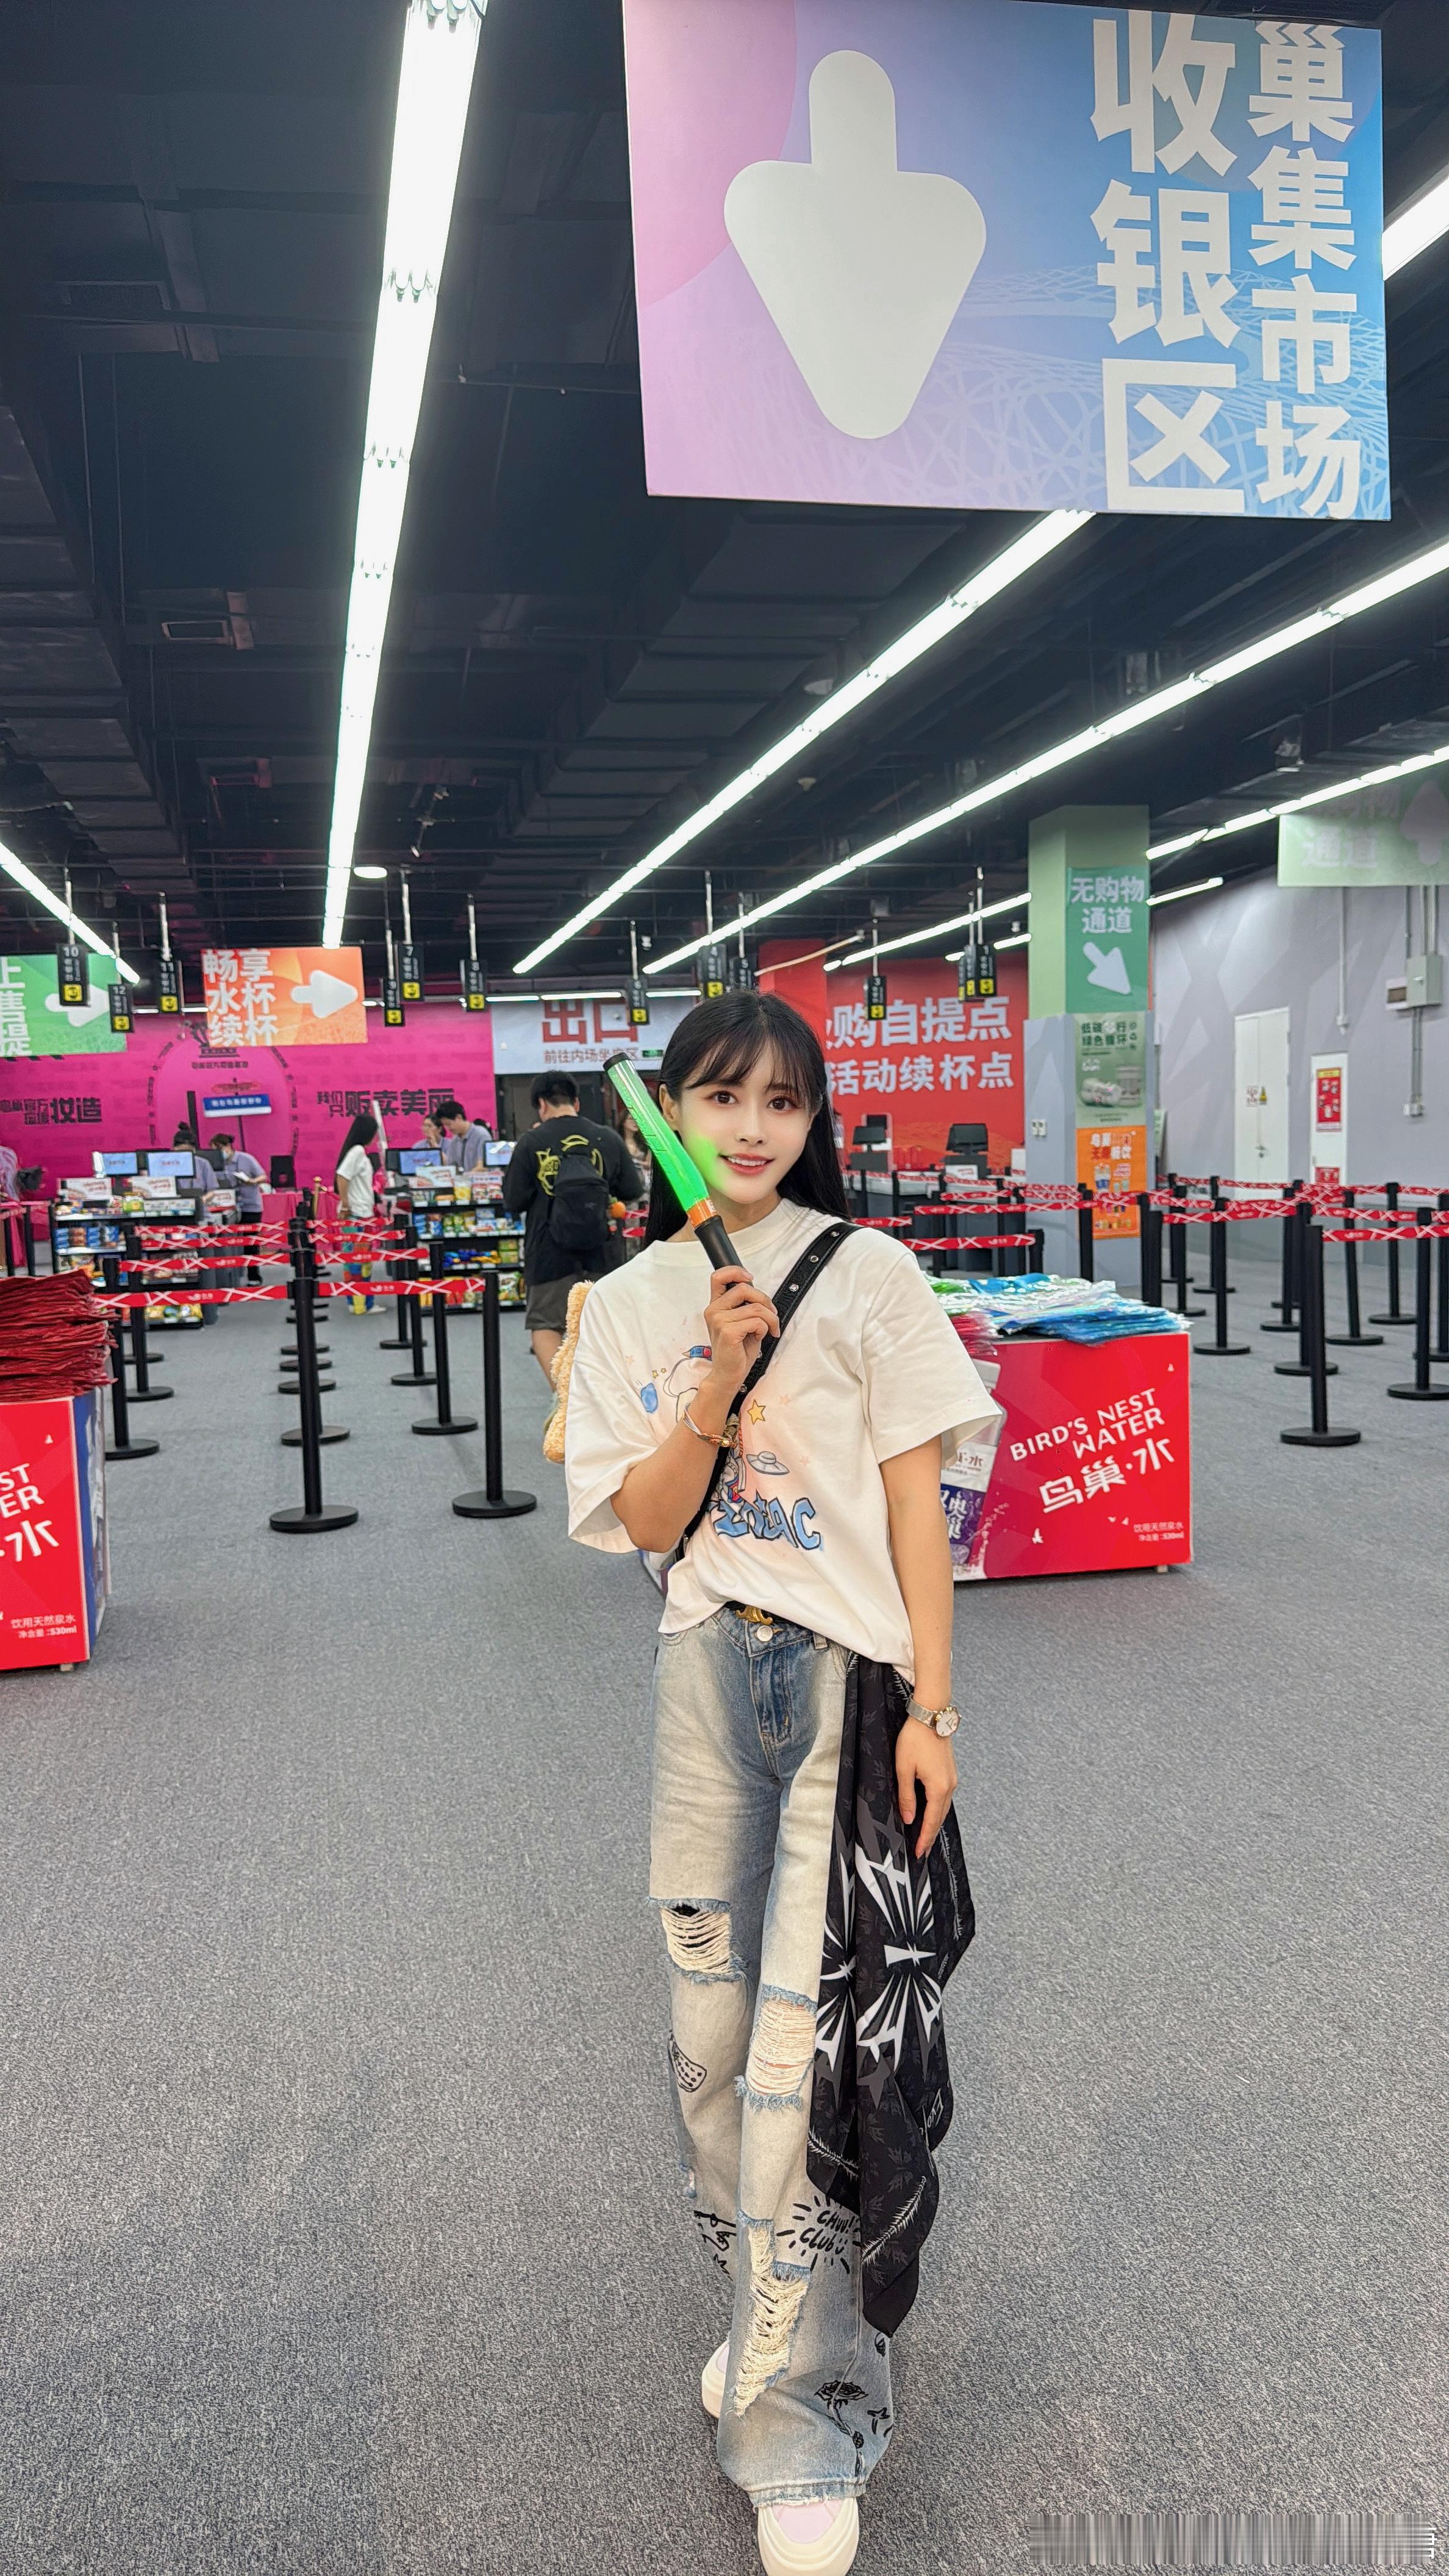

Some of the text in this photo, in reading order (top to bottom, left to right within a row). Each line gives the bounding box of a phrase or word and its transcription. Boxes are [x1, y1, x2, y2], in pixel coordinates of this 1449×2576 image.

[1090, 10, 1245, 513] 收银区
[1248, 20, 1361, 519] 巢集市场
[1071, 875, 1145, 904] 无购物
[1081, 906, 1132, 934] 通道
[63, 946, 79, 957] 10
[160, 962, 174, 972] 11
[202, 948, 273, 983] 畅享
[112, 986, 127, 995] 12
[206, 981, 276, 1015] 水杯
[208, 1014, 278, 1046] 续杯
[542, 998, 639, 1044] 出口
[825, 1051, 1014, 1096] 活动续杯点
[50, 1097, 102, 1123] 妆造
[345, 1089, 454, 1117] 贩卖美丽
[1009, 1387, 1156, 1462] BIRD'S NEST
[1072, 1407, 1165, 1459] WATER
[10, 1613, 77, 1630] 饮用天然泉水
